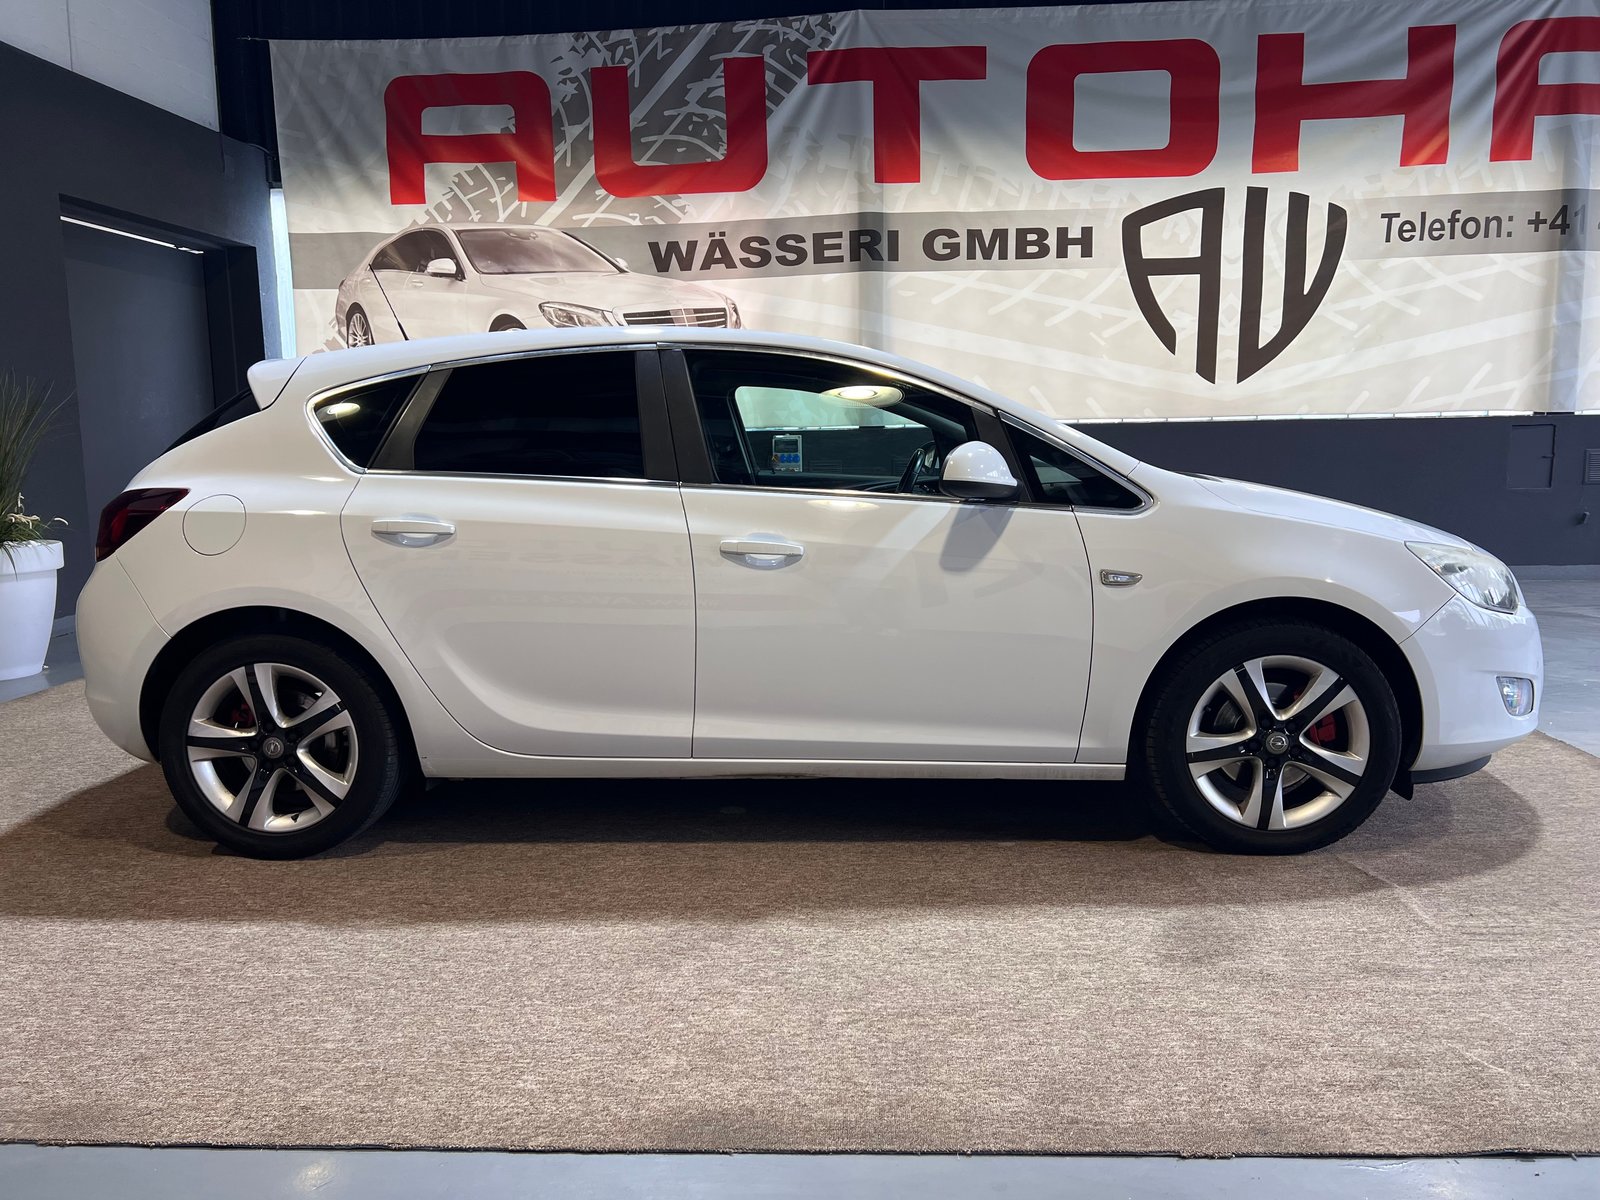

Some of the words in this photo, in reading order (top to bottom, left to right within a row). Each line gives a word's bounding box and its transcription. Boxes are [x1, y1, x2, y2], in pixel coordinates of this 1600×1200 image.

[1380, 209, 1514, 243] Telefon:
[1527, 204, 1586, 236] +41
[647, 229, 900, 273] WÄSSERI
[922, 226, 1093, 262] GMBH
